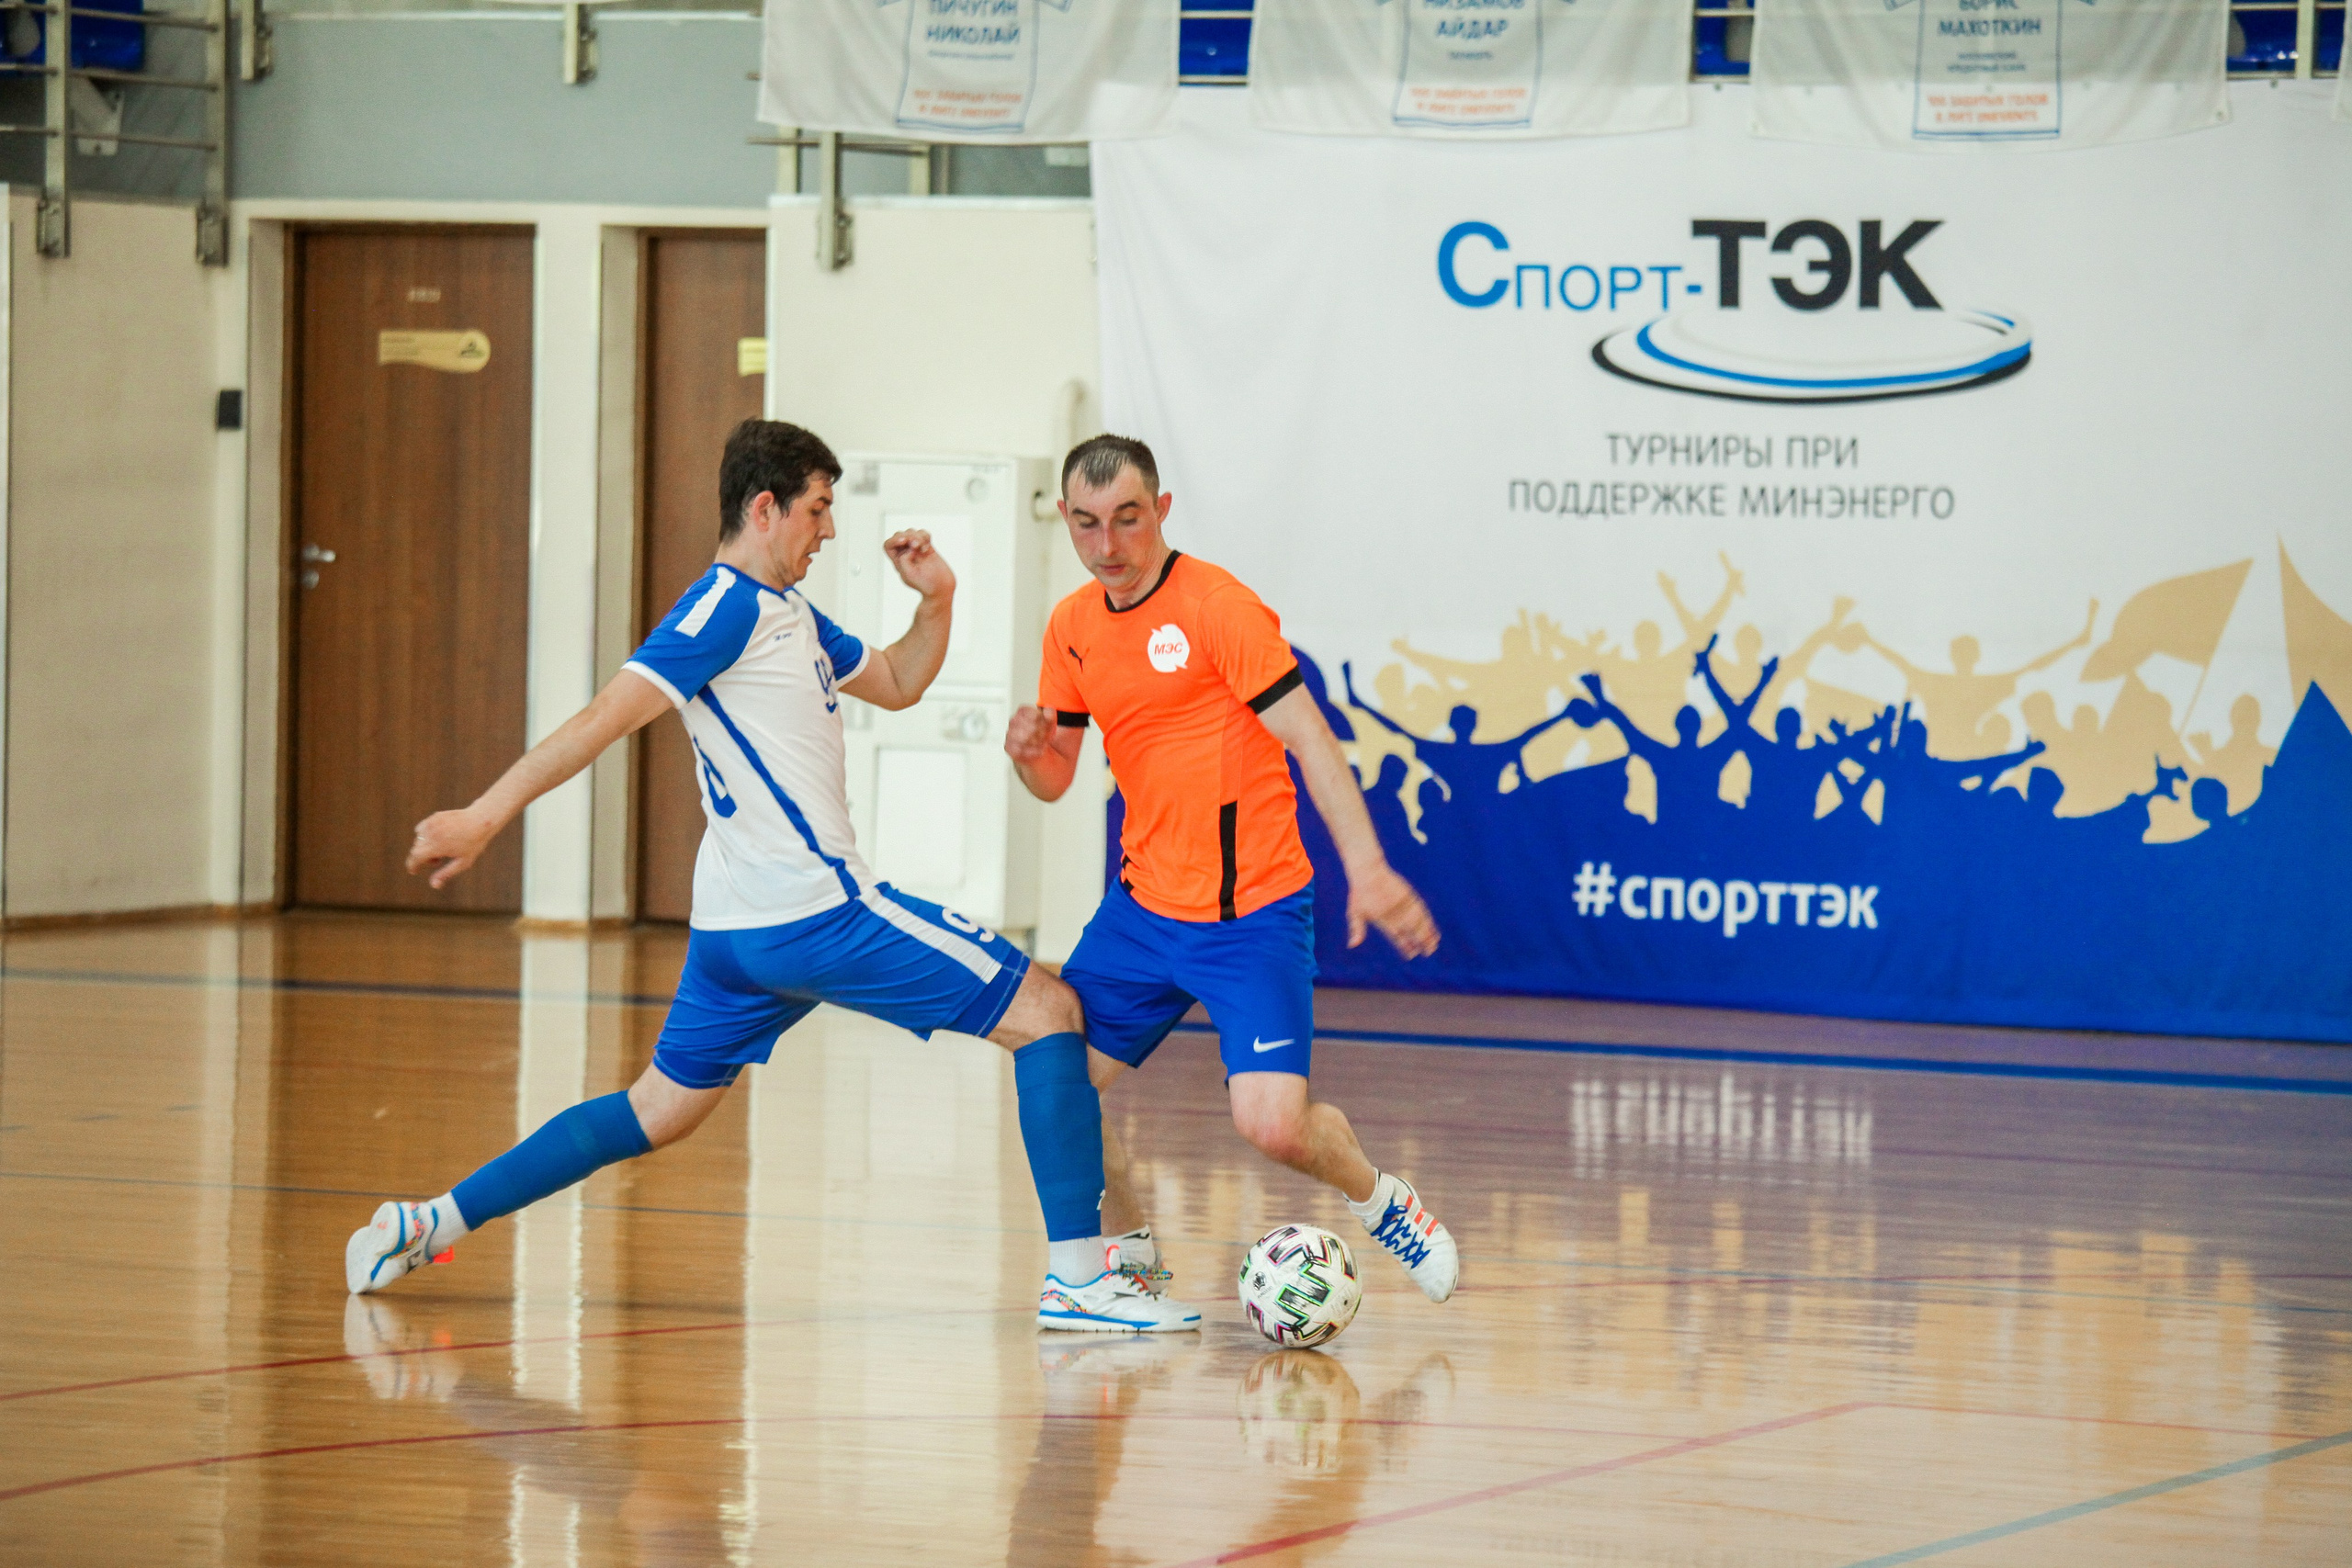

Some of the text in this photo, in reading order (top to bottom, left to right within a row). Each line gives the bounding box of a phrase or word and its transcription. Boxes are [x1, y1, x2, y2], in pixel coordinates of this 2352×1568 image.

[925, 24, 1021, 44] НИКОЛАЙ
[1938, 18, 2041, 37] МАХОТКИН
[1606, 433, 1860, 469] ТУРНИРЫ ПРИ
[1509, 479, 1956, 520] ПОДДЕРЖКЕ МИНЭНЕРГО
[1154, 641, 1183, 655] МЭС
[1572, 862, 1879, 938] #спорттэк
